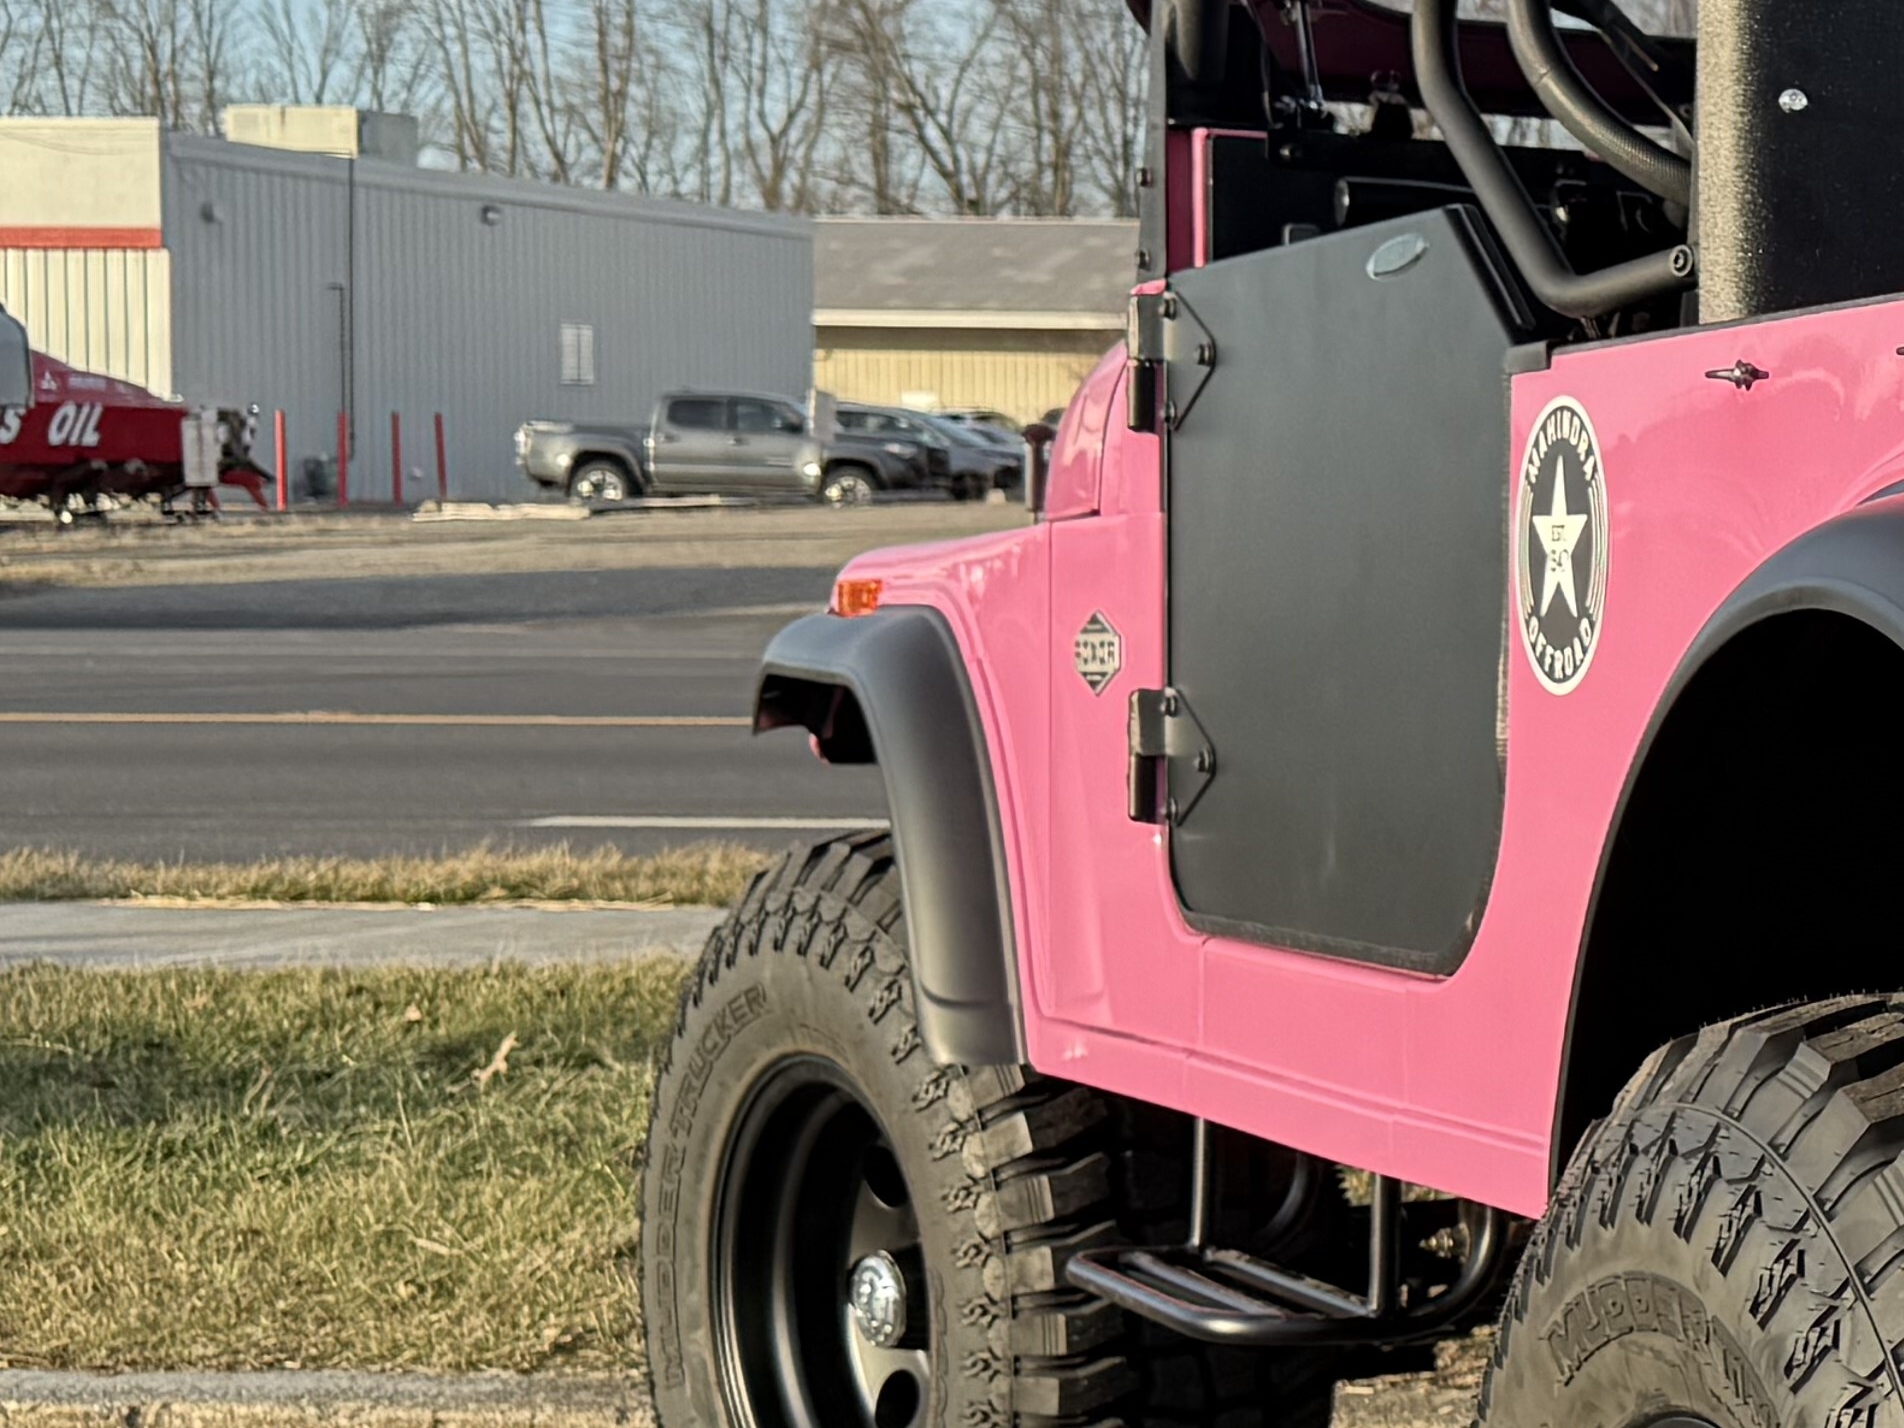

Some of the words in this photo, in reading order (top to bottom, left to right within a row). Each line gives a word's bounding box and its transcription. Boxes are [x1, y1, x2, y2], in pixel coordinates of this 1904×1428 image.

[48, 401, 104, 447] OIL
[1526, 409, 1597, 484] MAHINDRA
[1527, 615, 1593, 679] OFFROAD
[668, 983, 767, 1138] TRUCKER
